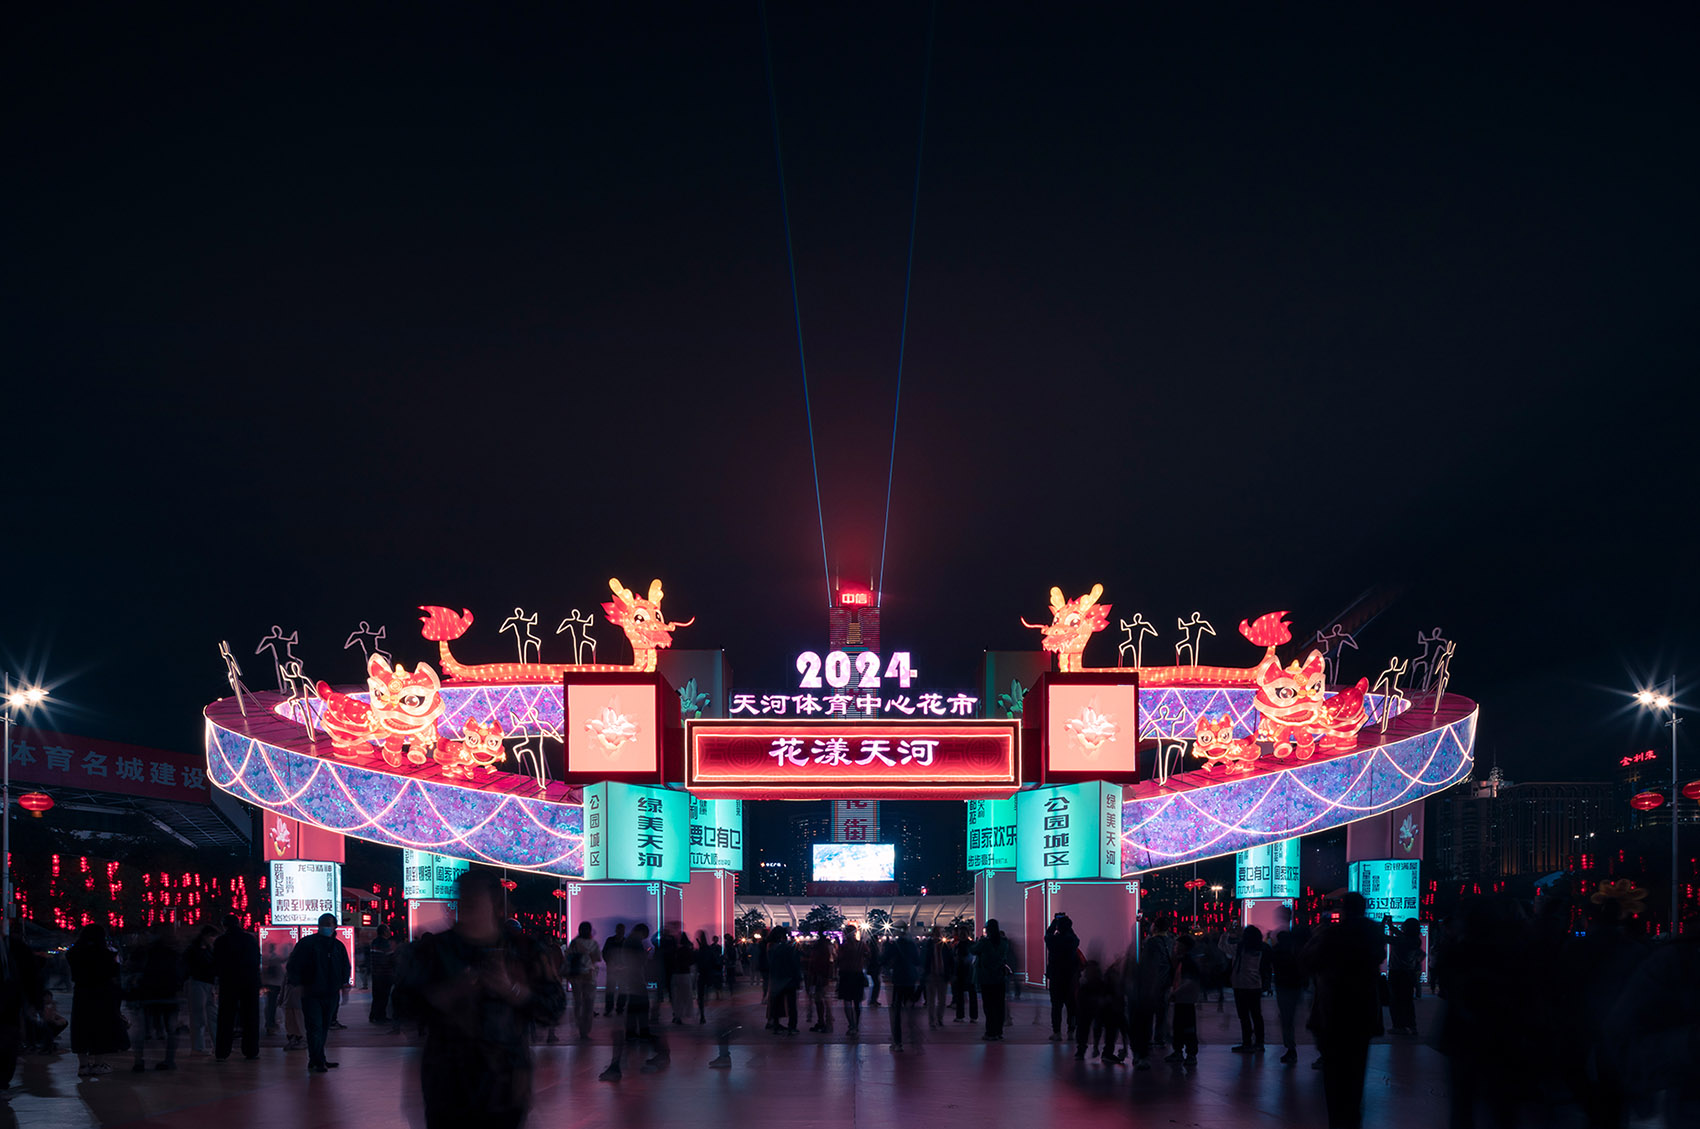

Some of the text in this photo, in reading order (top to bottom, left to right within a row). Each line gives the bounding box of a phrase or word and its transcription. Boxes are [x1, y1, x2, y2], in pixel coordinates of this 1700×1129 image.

[842, 593, 867, 604] 中信
[796, 650, 918, 689] 2024
[729, 693, 978, 716] 天河体育中心花市
[3, 739, 206, 790] 体育名城建设
[768, 737, 939, 768] 花漾天河
[589, 795, 600, 866] 公园城区
[637, 797, 664, 868] 绿美天河
[690, 824, 741, 851] 要乜有乜
[1043, 796, 1070, 867] 公园城区
[1106, 794, 1116, 865] 绿美天河
[1238, 866, 1270, 882] 要乜有乜
[276, 899, 333, 912] 靓到爆镜
